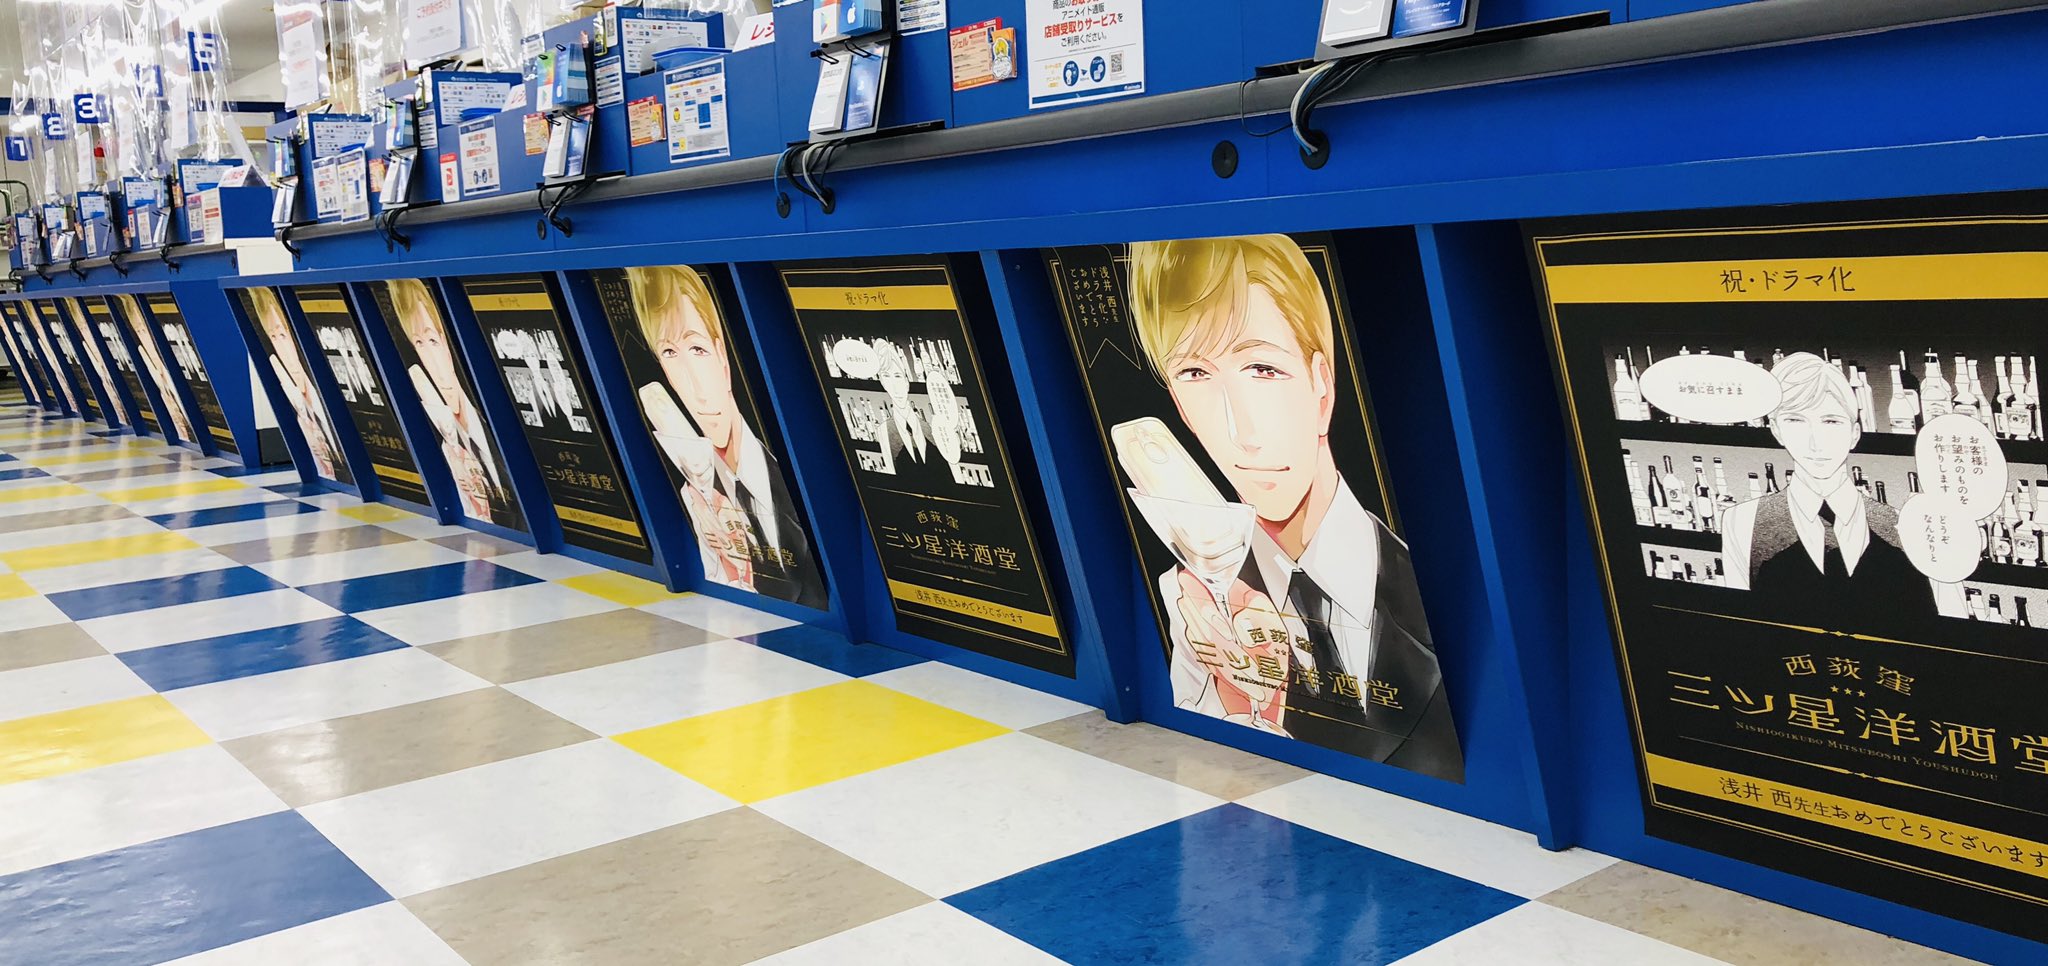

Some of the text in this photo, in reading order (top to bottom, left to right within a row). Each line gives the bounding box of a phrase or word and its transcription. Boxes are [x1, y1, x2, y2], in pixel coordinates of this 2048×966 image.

[1044, 12, 1123, 38] 店舗受取りサービスを
[1062, 3, 1104, 20] アニメイト通販
[1061, 31, 1107, 47] ご利用ください。
[78, 97, 95, 119] 3
[47, 116, 66, 136] 2
[13, 140, 25, 156] 1
[1719, 265, 1856, 294] 祝・ドラマ化
[1679, 385, 1743, 395] お気に召すまま
[1934, 434, 1950, 493] お作りします
[1951, 434, 1969, 505] お望みのものを
[1969, 436, 1984, 475] お客様の
[1924, 514, 1937, 562] なんなりと
[1940, 515, 1951, 545] どうぞ
[881, 525, 1021, 571] 三ツ星洋酒堂
[1191, 639, 1404, 710] 三ツ星洋酒堂
[1782, 653, 1917, 697] 西荻窪
[1719, 776, 1764, 802] 浅井
